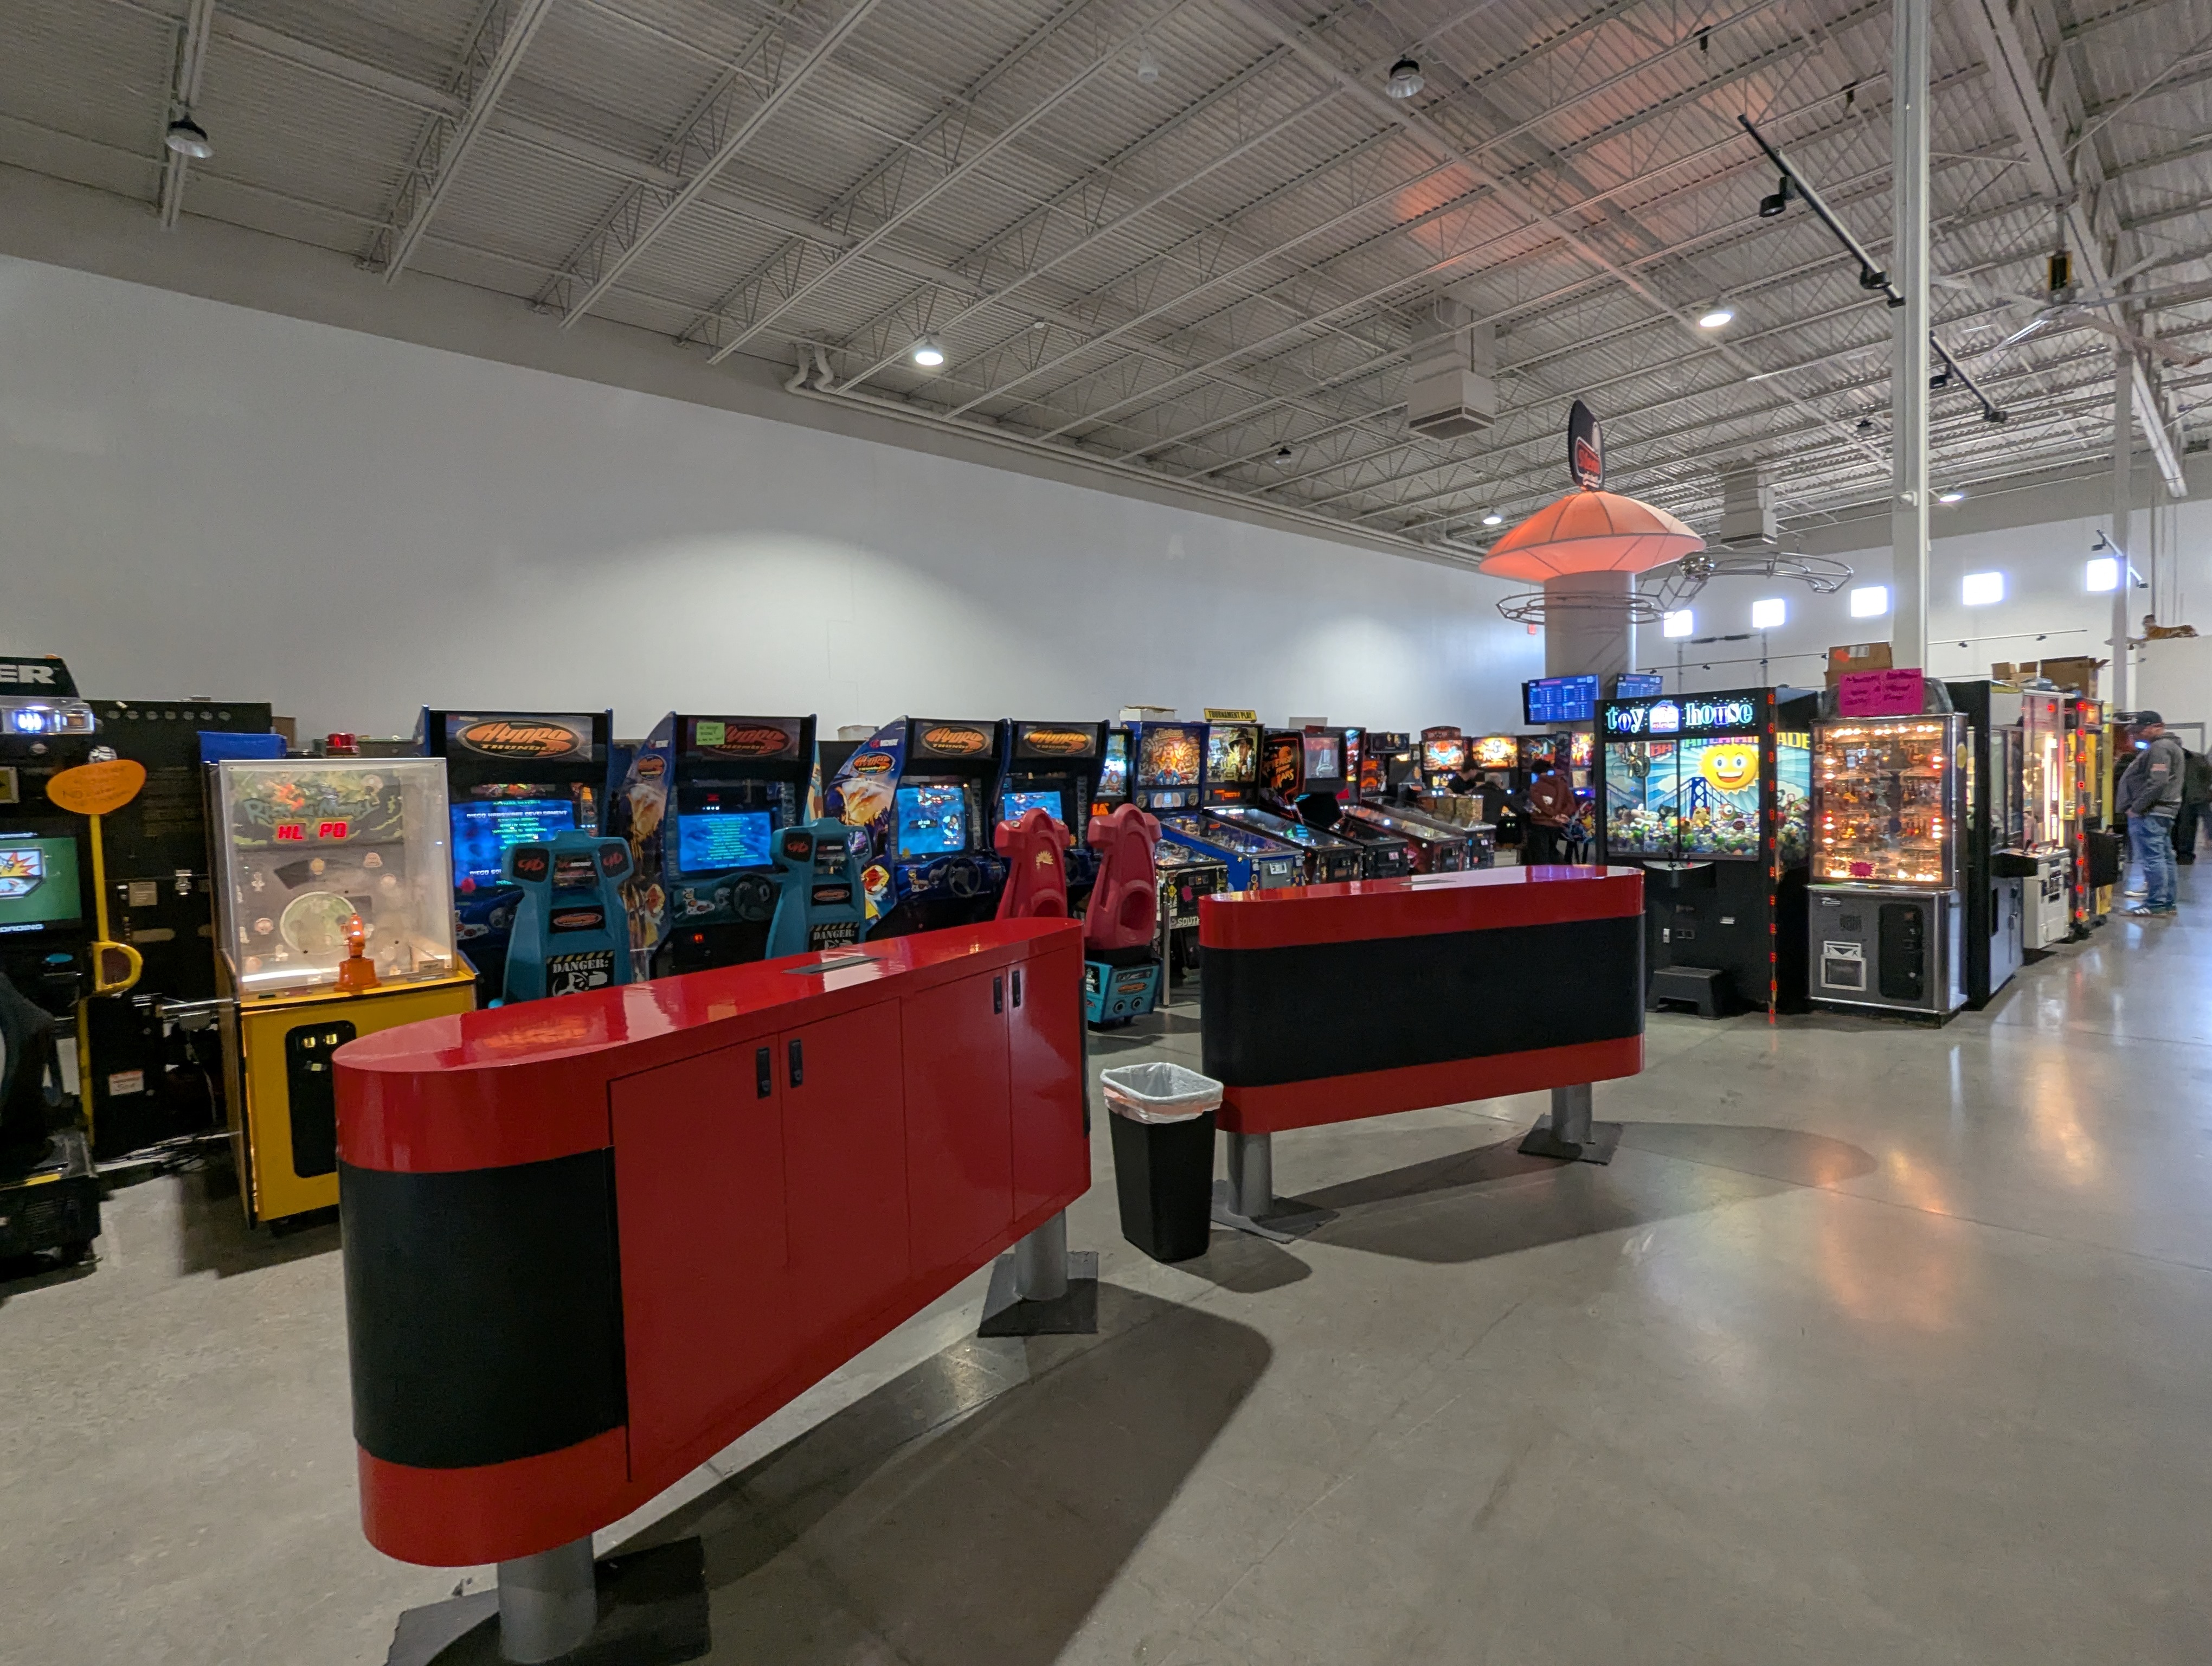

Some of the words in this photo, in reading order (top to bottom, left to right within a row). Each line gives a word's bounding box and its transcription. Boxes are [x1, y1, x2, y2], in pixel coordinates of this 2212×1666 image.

[1208, 710, 1240, 719] TOURNAMENT
[1605, 707, 1645, 733] toy
[1685, 702, 1753, 726] house
[466, 722, 573, 744] HYDRO
[925, 727, 984, 744] HYDRO
[1030, 730, 1086, 744] HYDRO
[813, 929, 854, 940] DANGER:
[553, 959, 608, 973] DANGER:
